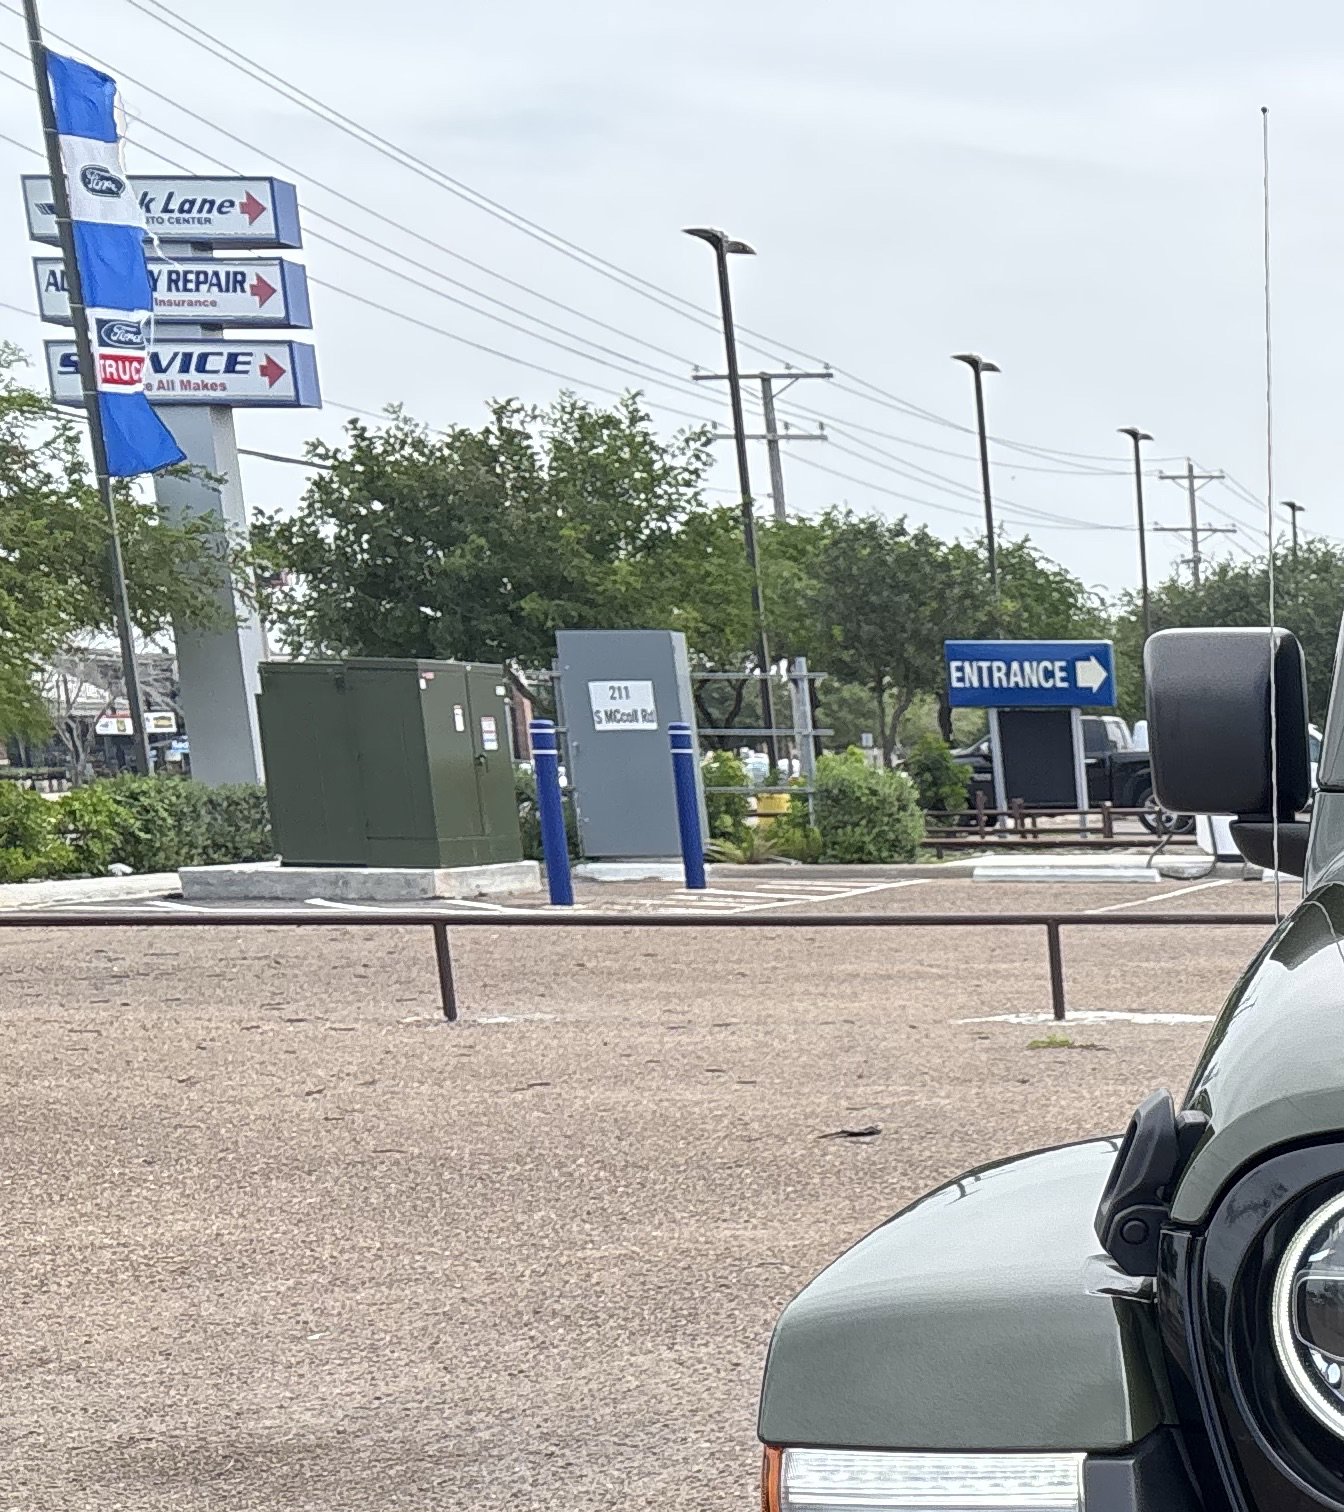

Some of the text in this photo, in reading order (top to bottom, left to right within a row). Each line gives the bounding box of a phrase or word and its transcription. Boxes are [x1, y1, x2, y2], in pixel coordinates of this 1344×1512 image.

[161, 191, 235, 215] Lane
[167, 217, 212, 225] CENTER
[166, 270, 247, 293] REPAIR
[154, 297, 218, 308] Insurance
[156, 379, 175, 392] All
[180, 379, 227, 392] Makes
[949, 660, 1069, 688] ENTRANCE
[608, 685, 631, 701] 211
[594, 709, 603, 724] S
